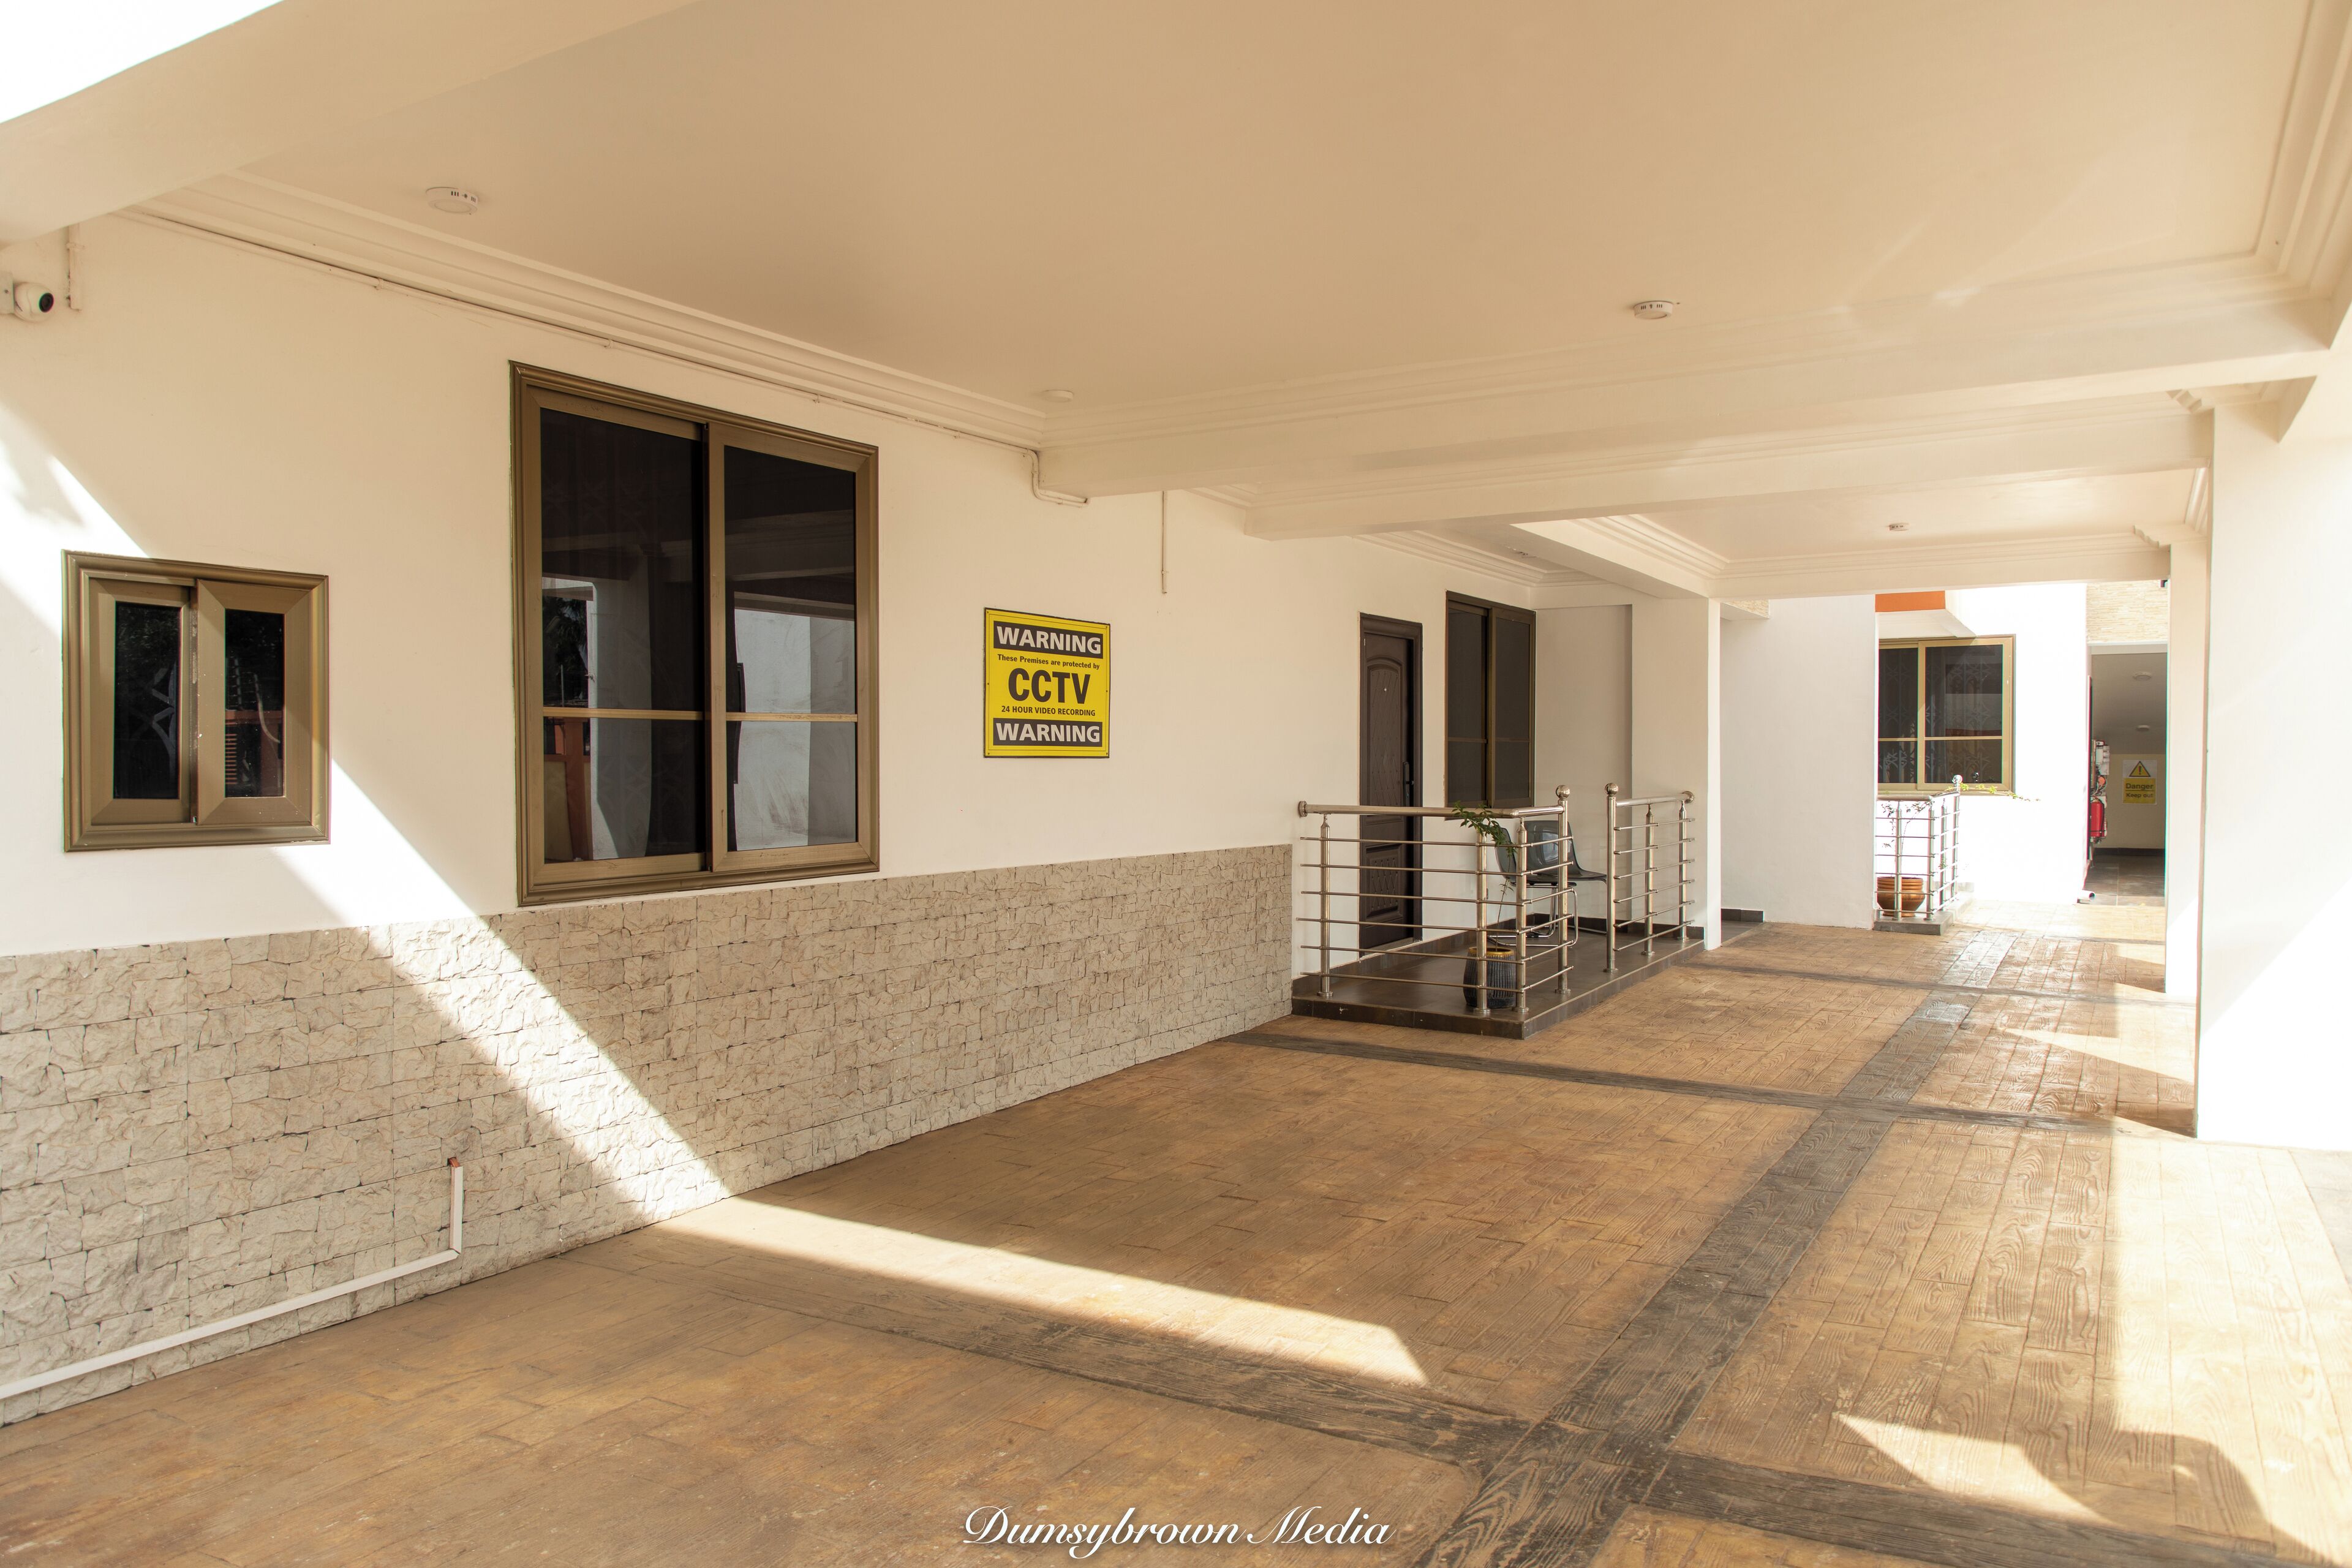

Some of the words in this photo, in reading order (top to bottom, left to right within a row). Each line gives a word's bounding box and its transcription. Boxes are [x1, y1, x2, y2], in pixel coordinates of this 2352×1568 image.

[997, 625, 1101, 654] WARNING
[998, 654, 1017, 662] These
[1020, 656, 1049, 665] Premises
[1062, 660, 1091, 669] protected
[1008, 668, 1091, 704] CCTV
[996, 722, 1100, 742] WARNING
